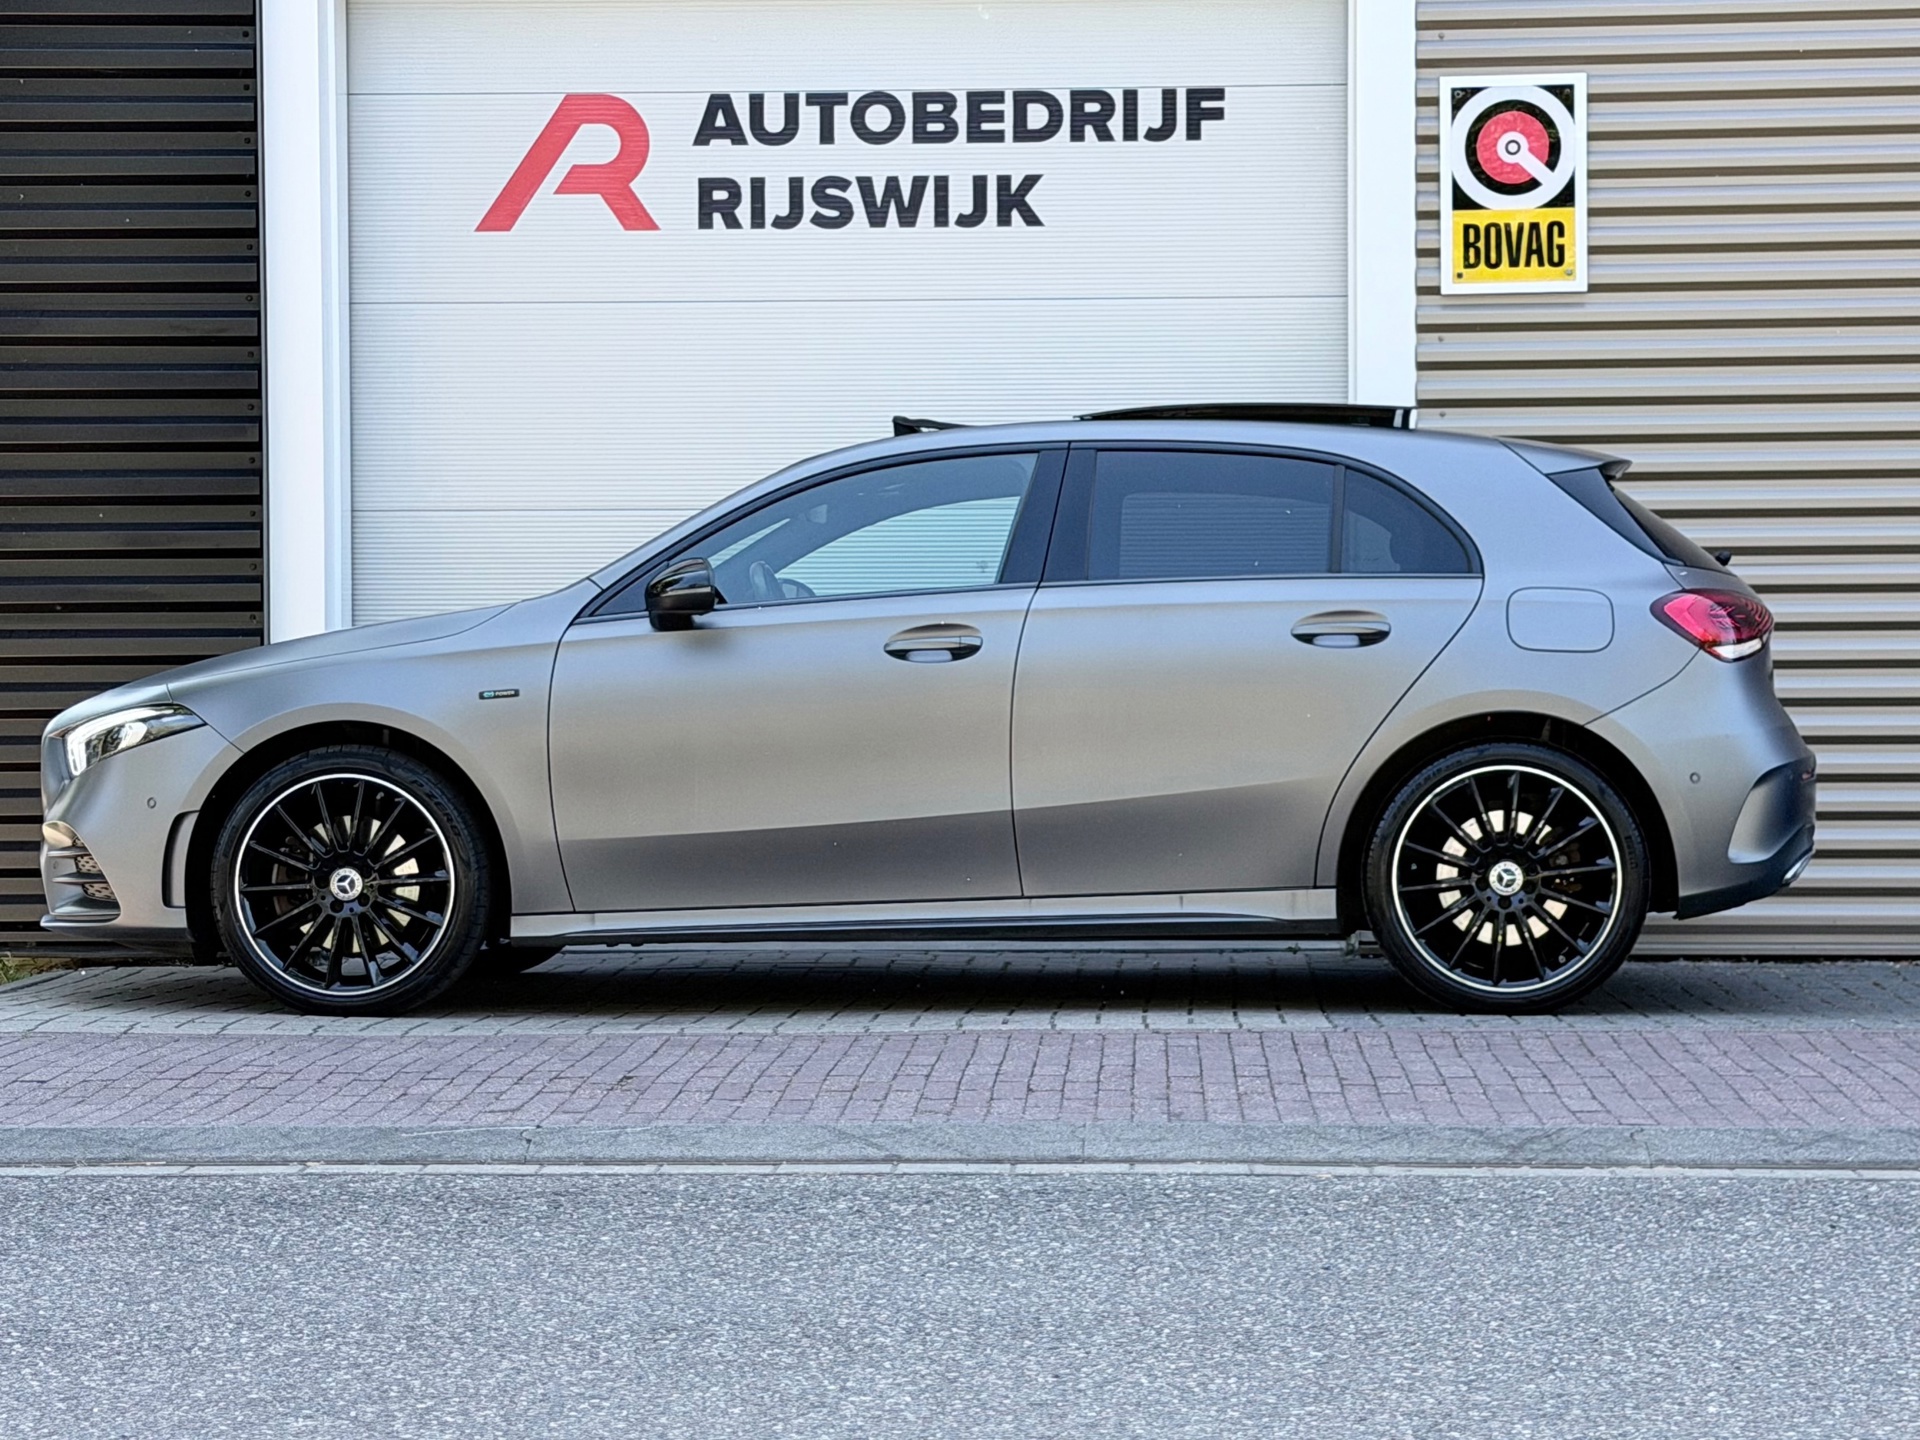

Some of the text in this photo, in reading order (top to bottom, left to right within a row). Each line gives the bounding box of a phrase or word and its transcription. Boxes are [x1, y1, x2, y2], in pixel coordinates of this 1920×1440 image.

[692, 87, 1226, 146] AUTOBEDRIJF
[697, 174, 1044, 230] RIJSWIJK
[1463, 220, 1565, 269] BOVAG
